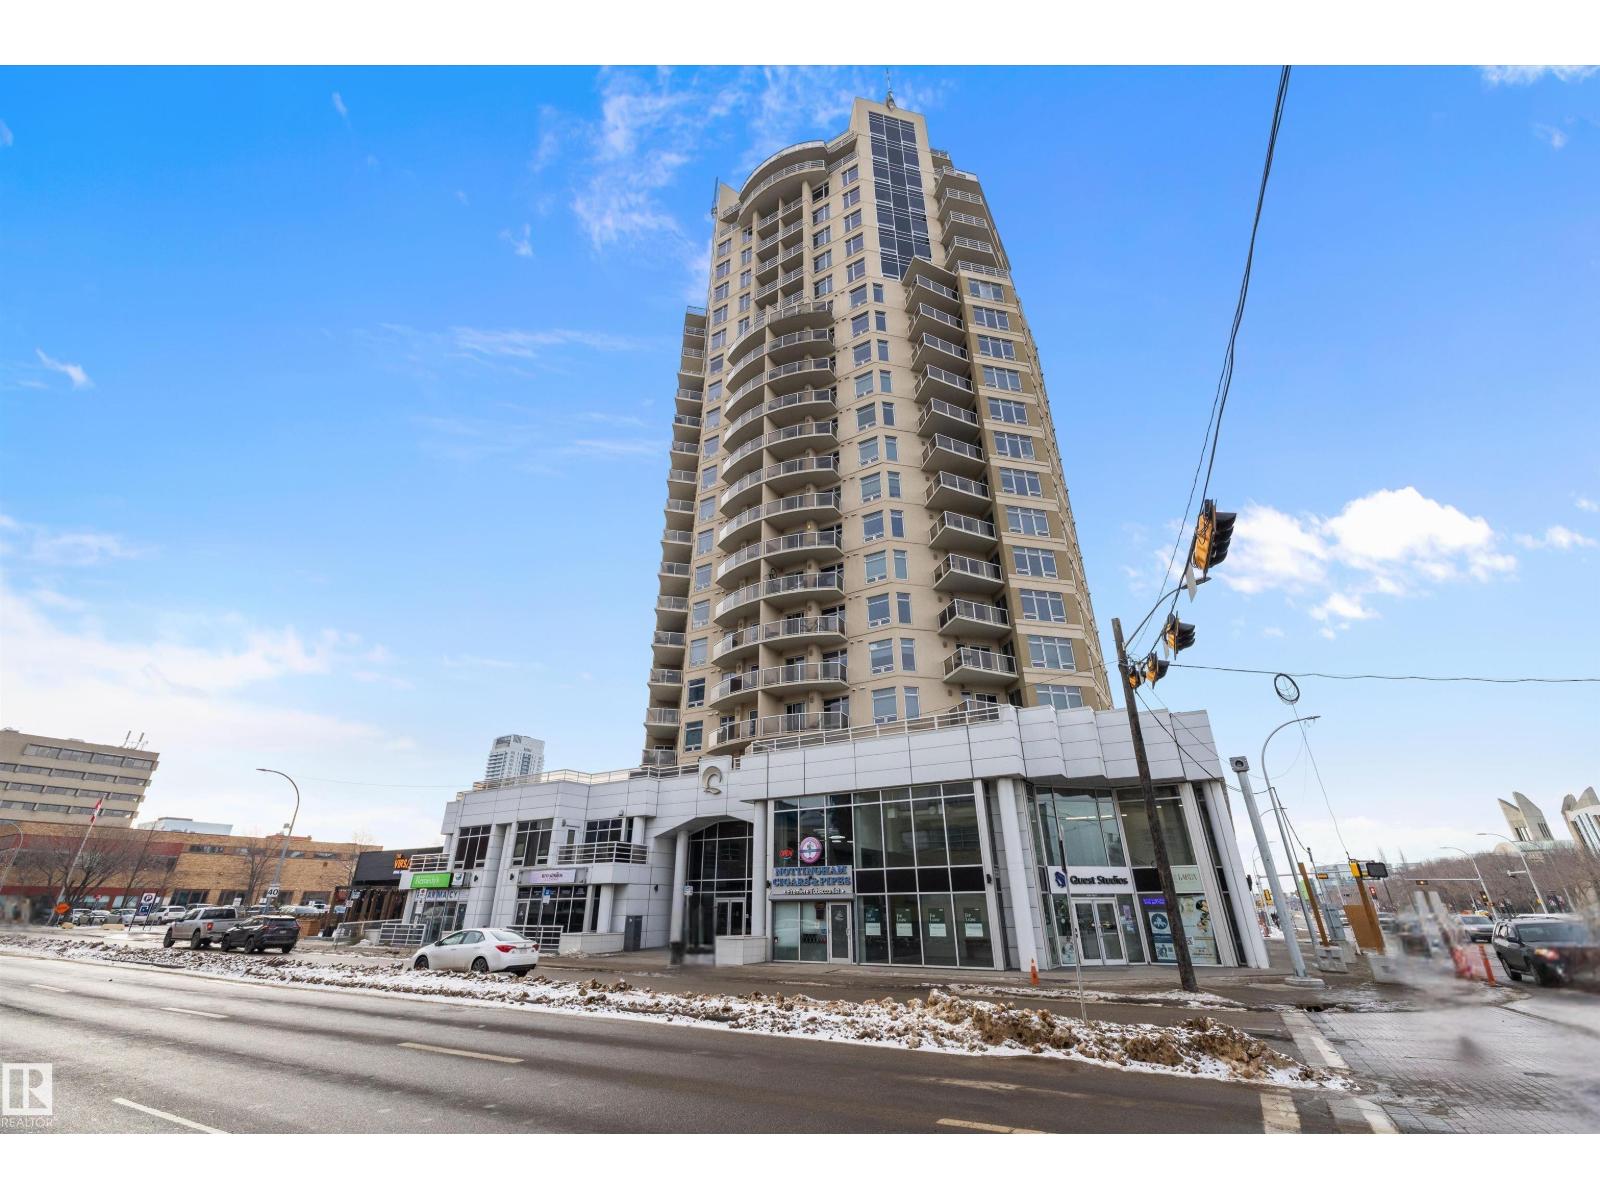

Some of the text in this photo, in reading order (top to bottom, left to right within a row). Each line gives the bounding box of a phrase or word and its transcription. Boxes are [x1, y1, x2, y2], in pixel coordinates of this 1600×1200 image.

[776, 866, 847, 876] NOTTINGHAM
[773, 878, 811, 887] CIGARS
[820, 877, 851, 886] PIPES
[1070, 875, 1128, 885] Quest Studios
[415, 889, 458, 899] PARMACY
